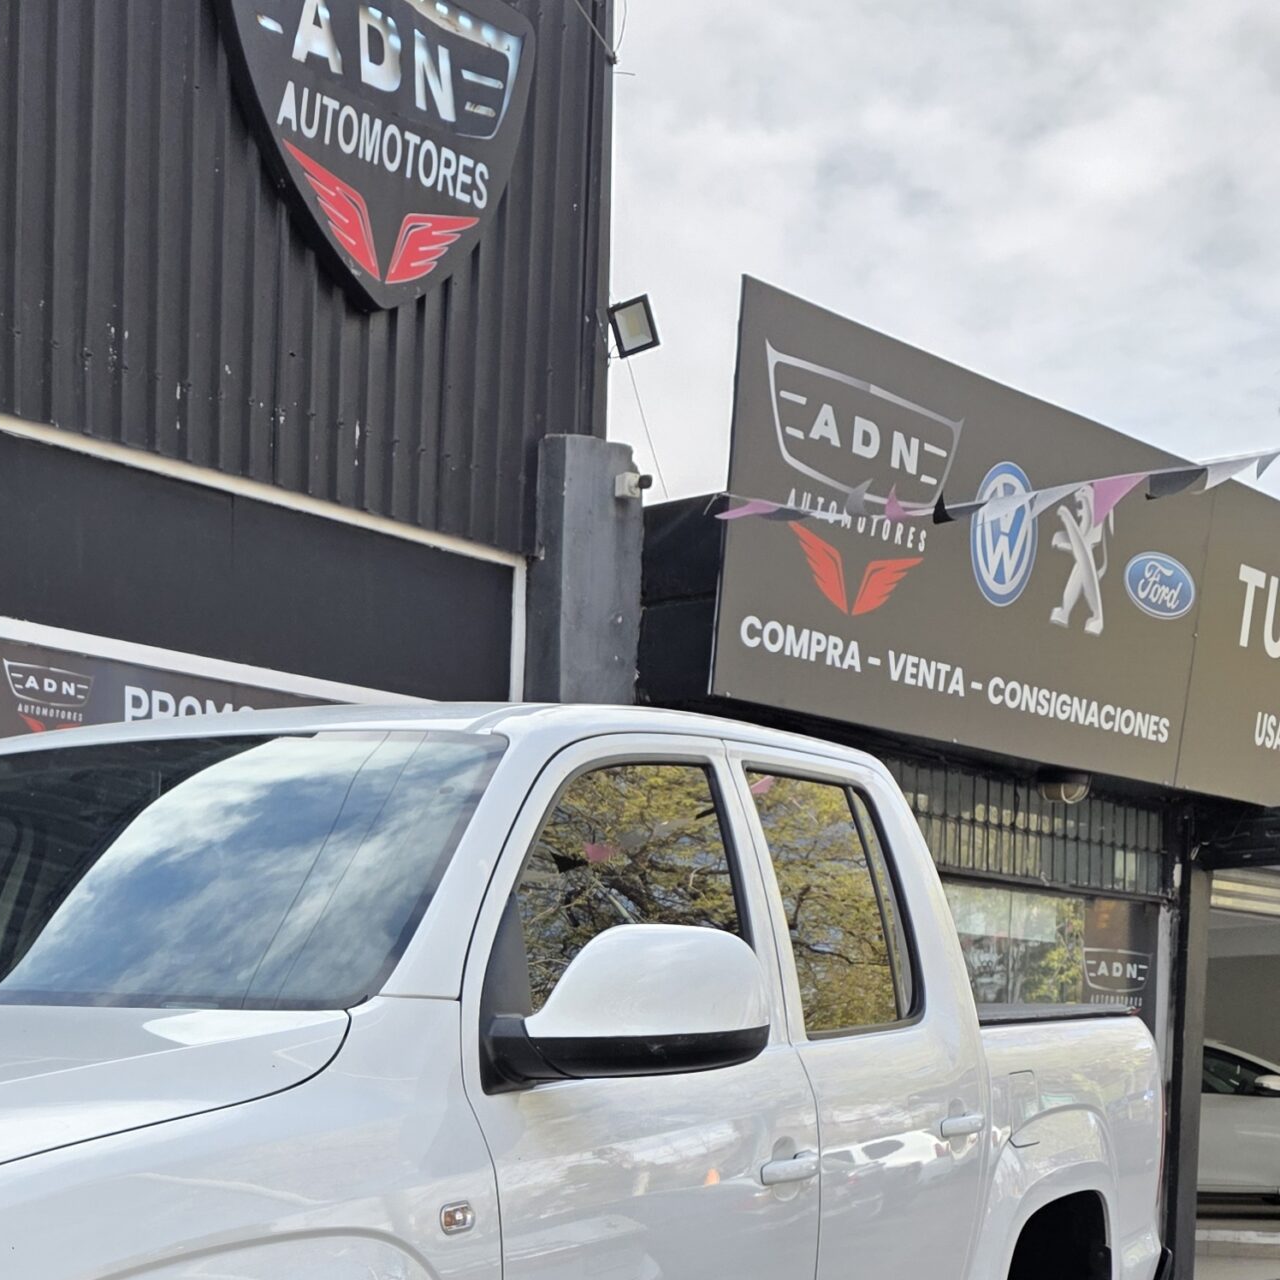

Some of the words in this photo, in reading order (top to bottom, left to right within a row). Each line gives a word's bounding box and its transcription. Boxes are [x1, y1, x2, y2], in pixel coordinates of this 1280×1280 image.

[292, 0, 456, 122] ADN
[276, 80, 489, 209] AUTOMOTORES
[809, 403, 920, 475] ADN
[1137, 560, 1183, 610] Ford
[25, 675, 76, 697] ADN
[741, 615, 861, 672] COMPRA
[888, 650, 965, 696] VENTA
[988, 676, 1170, 743] CONSIGNACIONES
[17, 703, 83, 722] AUTOMOTORES
[1097, 960, 1137, 979] ADN
